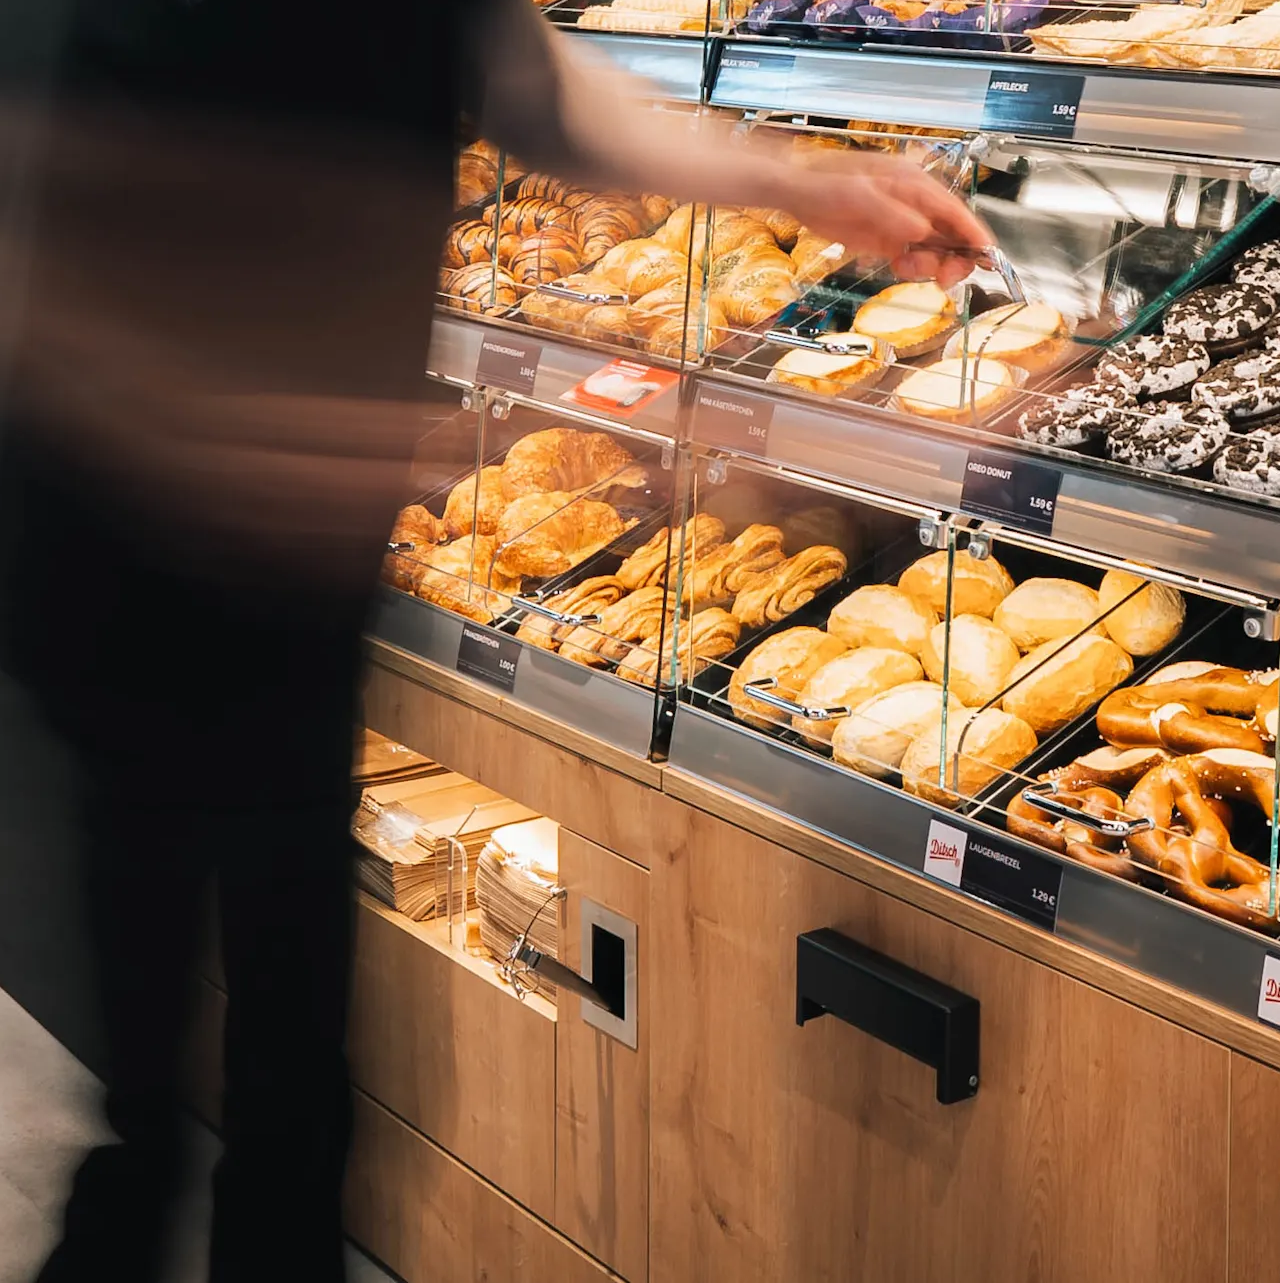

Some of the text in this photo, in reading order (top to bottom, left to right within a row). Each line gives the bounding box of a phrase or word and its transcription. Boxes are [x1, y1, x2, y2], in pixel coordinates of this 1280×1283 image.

[990, 81, 1029, 93] APFELECKE
[1069, 105, 1077, 115] €
[967, 462, 1013, 480] OREO DONUT
[1029, 497, 1053, 511] 1,59 €
[929, 838, 958, 859] Ditsch
[969, 842, 1021, 870] LAUGENBREZEL
[1032, 888, 1055, 906] 1,29 €
